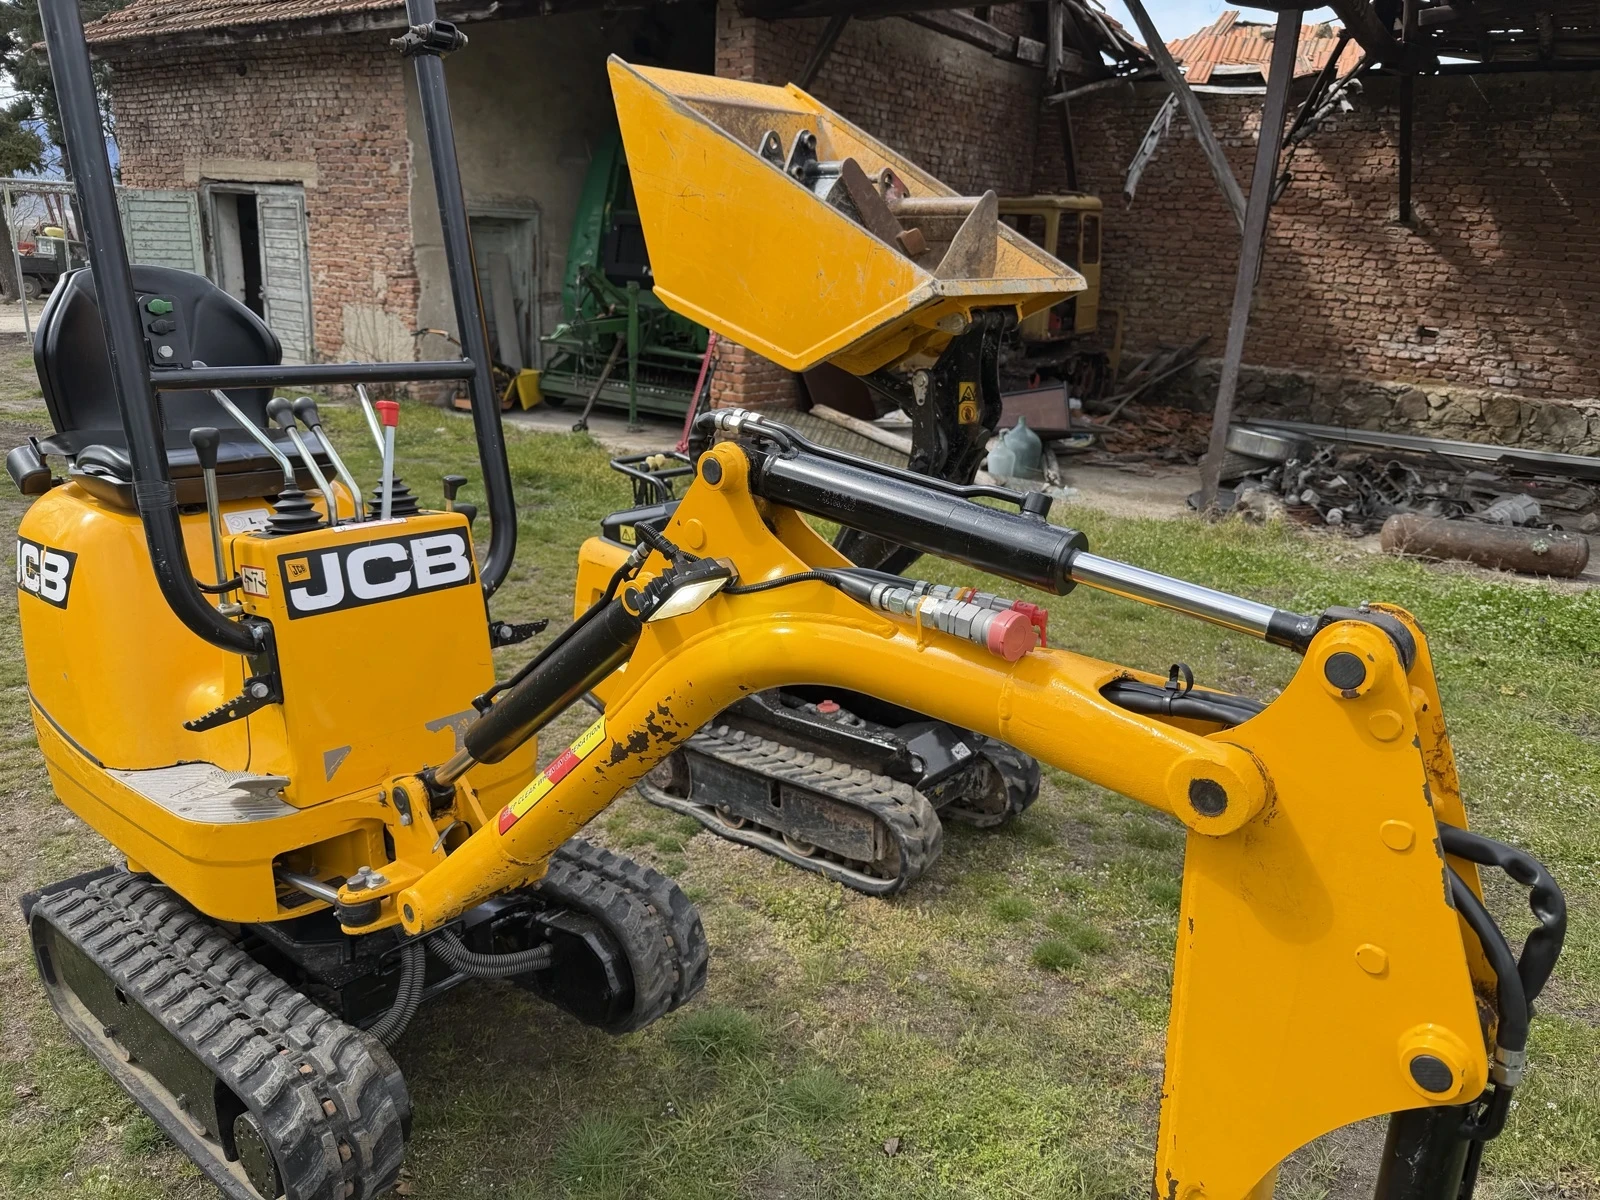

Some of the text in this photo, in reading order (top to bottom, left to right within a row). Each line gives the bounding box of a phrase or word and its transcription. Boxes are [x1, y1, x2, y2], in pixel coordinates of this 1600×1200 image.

[290, 533, 470, 611] JCB
[517, 783, 537, 804] CLEAR
[537, 766, 555, 785] WHEN
[563, 722, 602, 763] OPERATION
